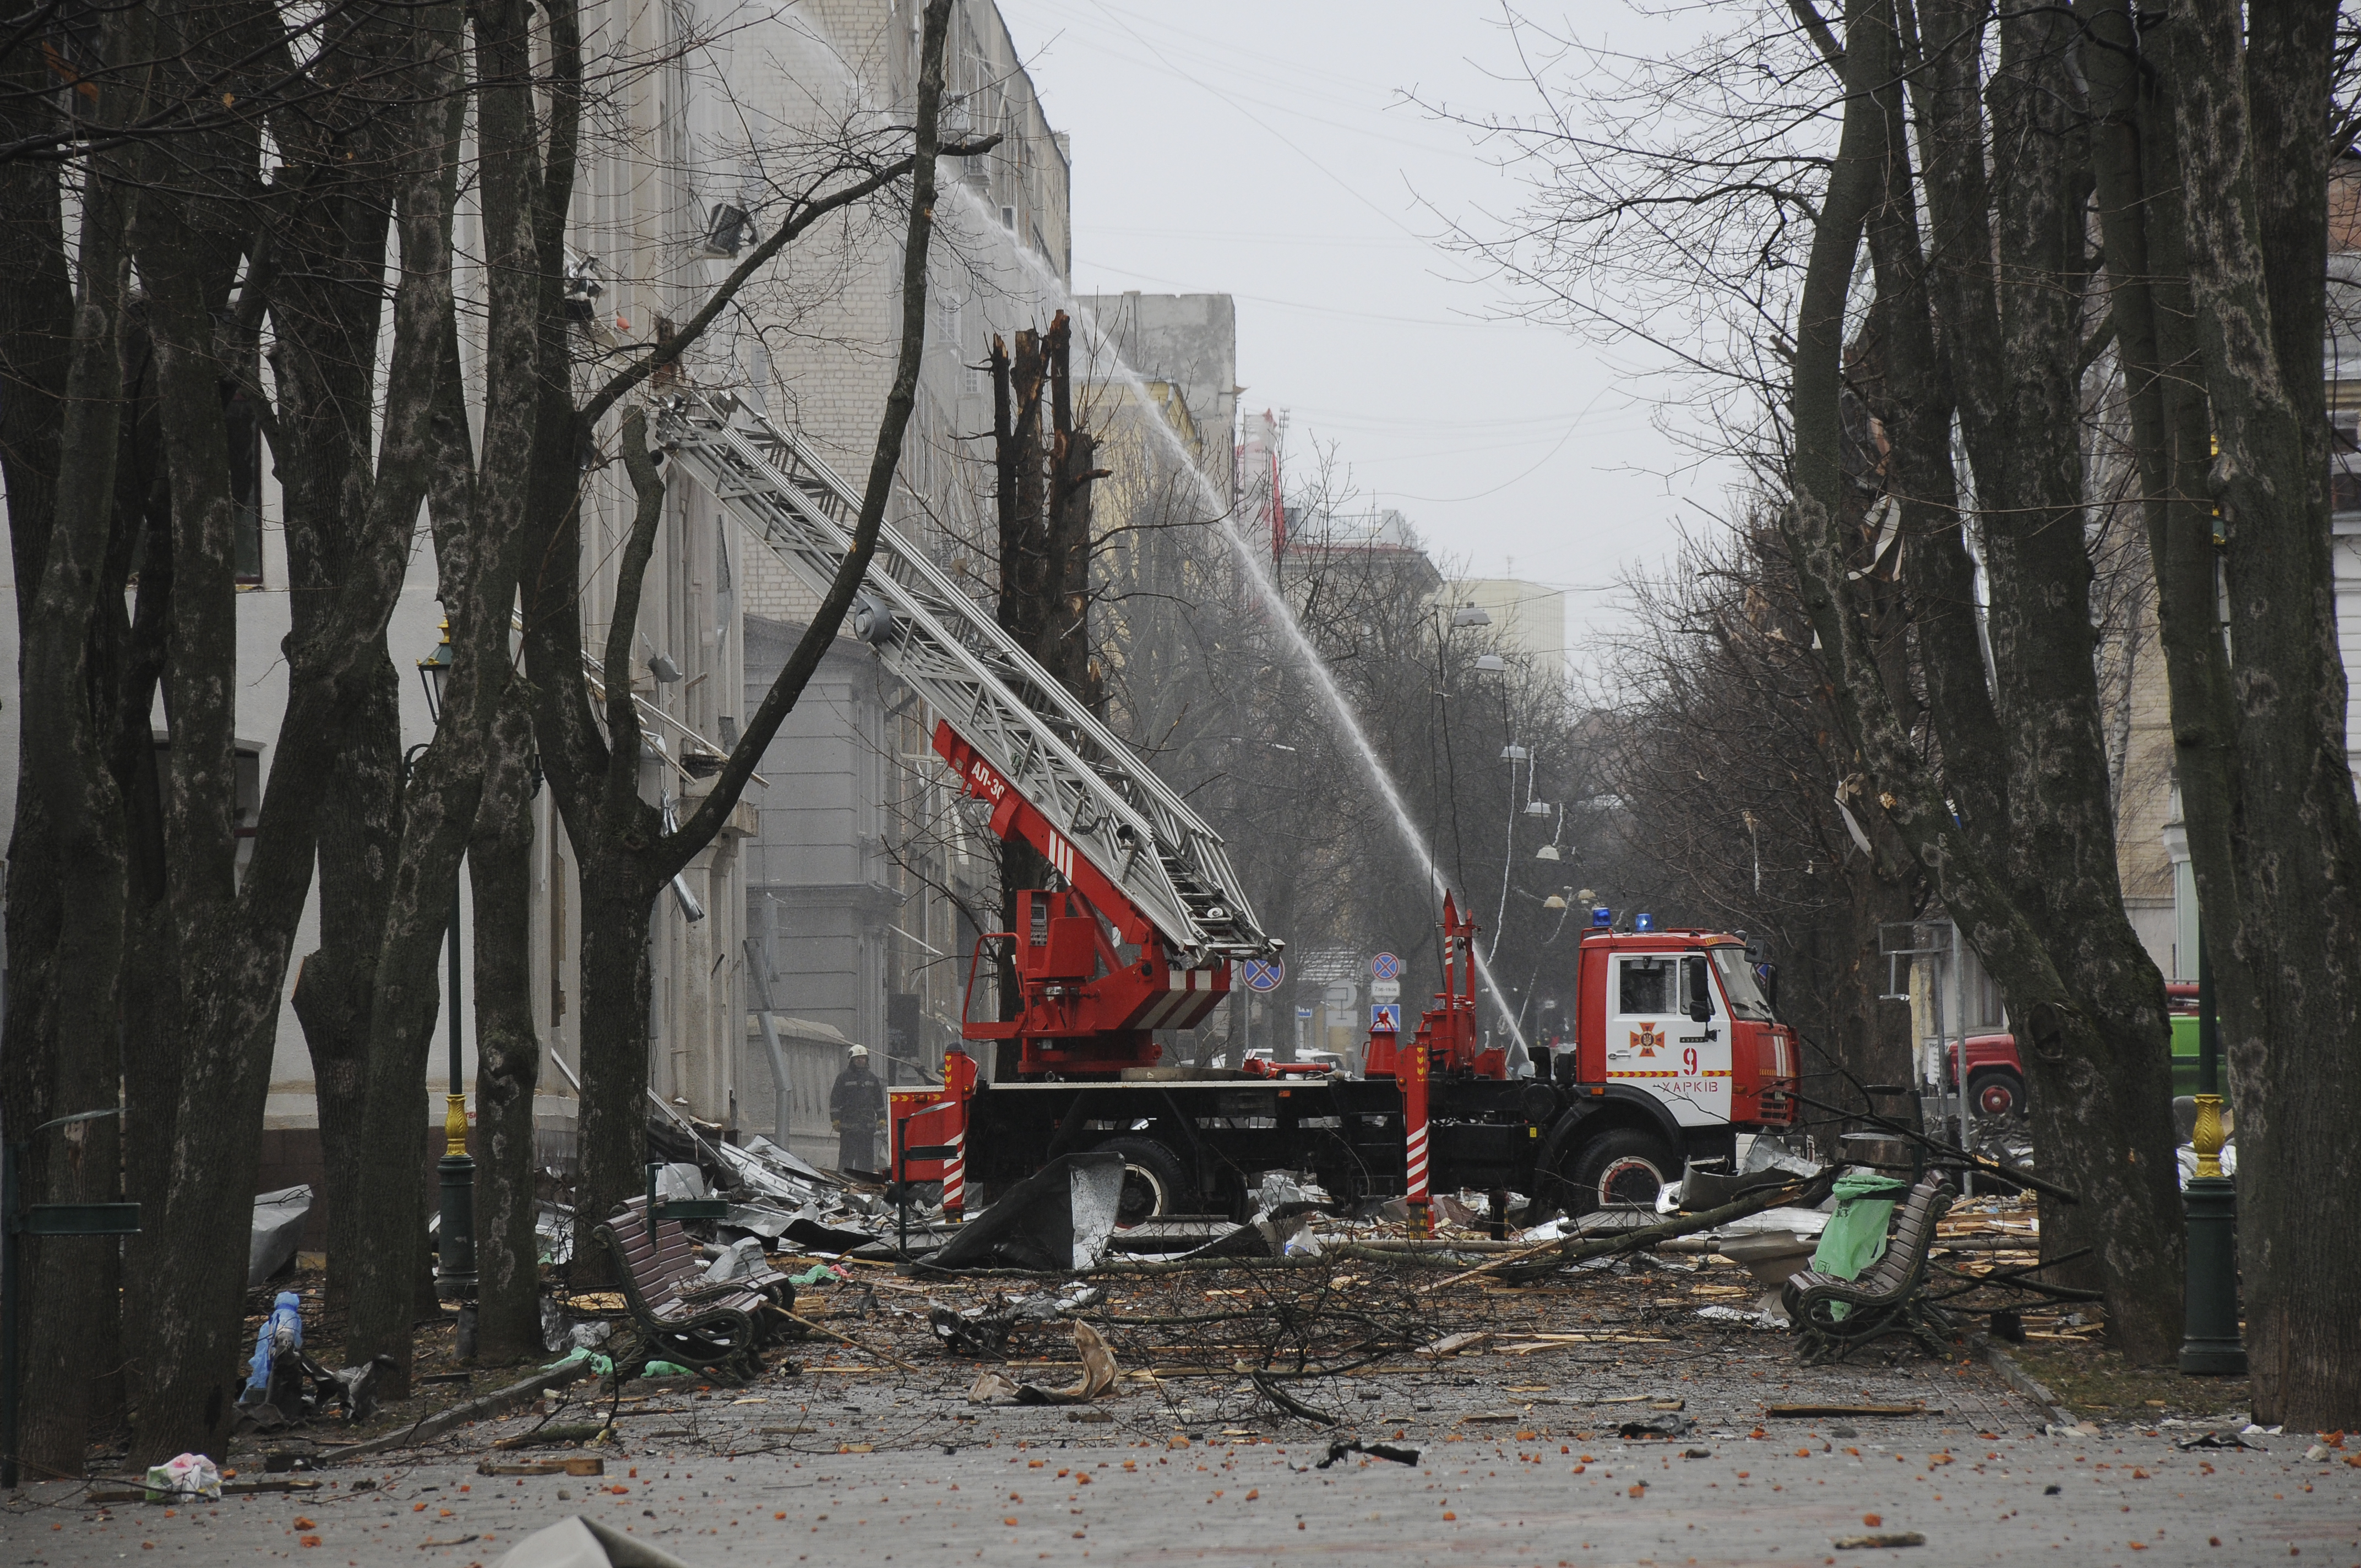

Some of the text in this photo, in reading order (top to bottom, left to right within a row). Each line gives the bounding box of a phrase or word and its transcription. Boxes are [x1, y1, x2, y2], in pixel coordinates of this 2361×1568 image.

[971, 761, 1005, 800] АЛ-30
[1683, 1047, 1698, 1076] 9
[1662, 1080, 1718, 1092] ХАРКІВ
